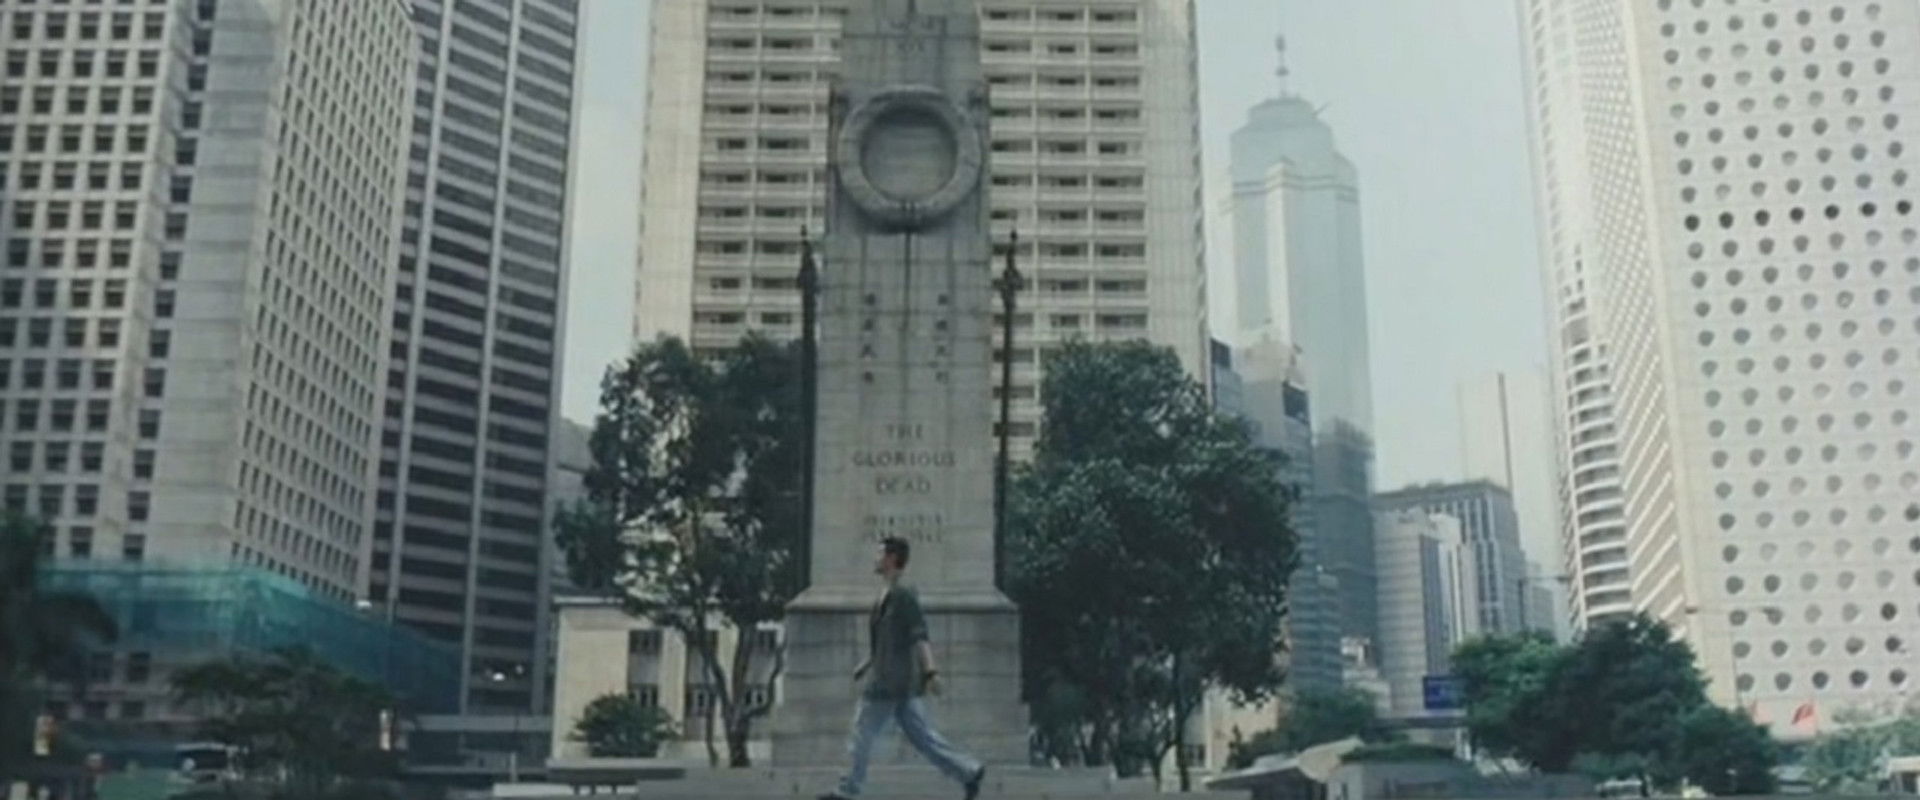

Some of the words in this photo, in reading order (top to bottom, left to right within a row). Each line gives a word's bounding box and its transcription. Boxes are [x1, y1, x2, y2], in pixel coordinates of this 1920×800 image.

[886, 424, 923, 439] THE
[853, 450, 956, 467] GLORIOUS
[875, 476, 931, 494] DEAD
